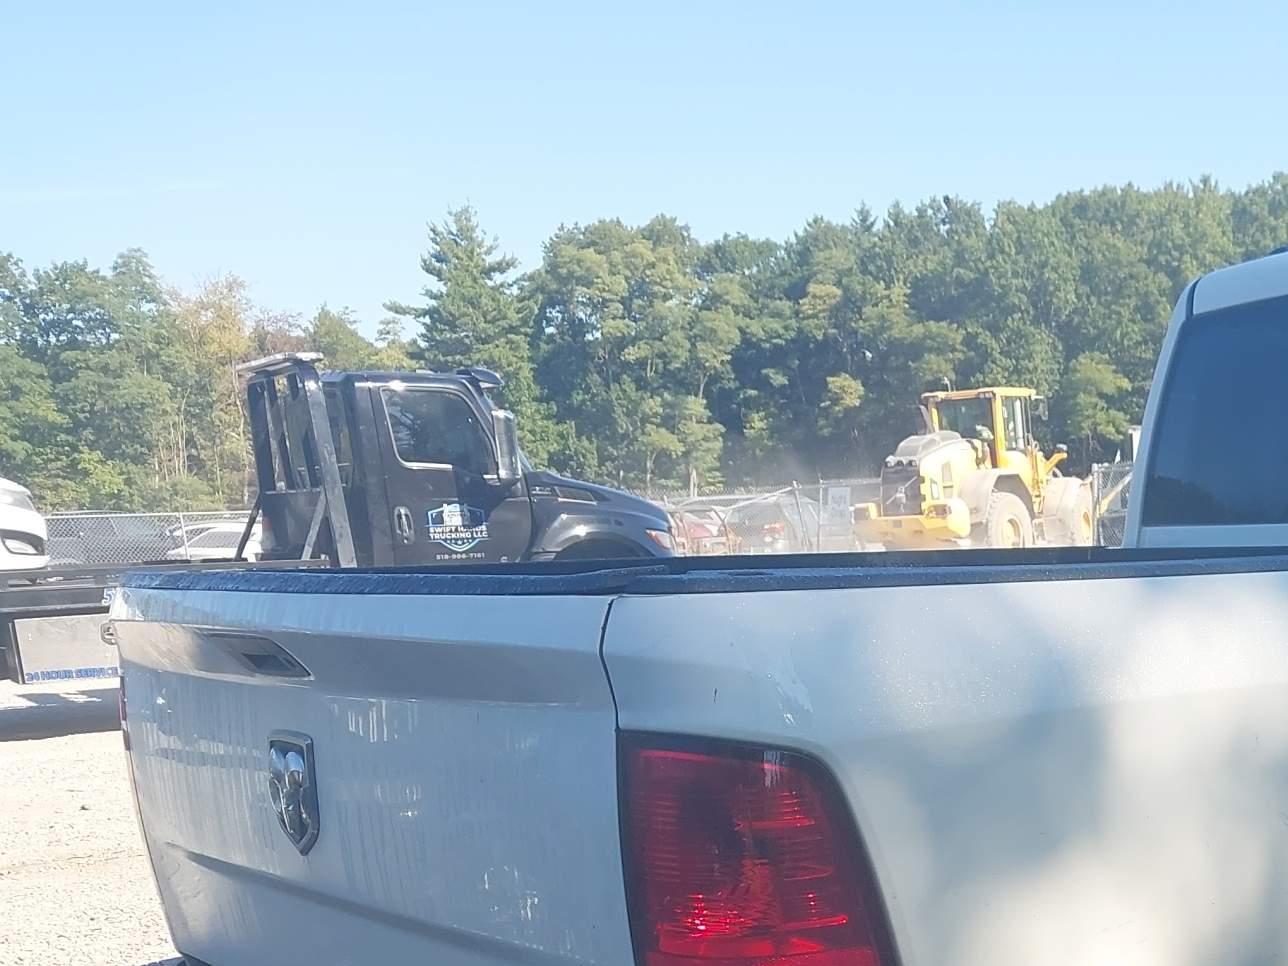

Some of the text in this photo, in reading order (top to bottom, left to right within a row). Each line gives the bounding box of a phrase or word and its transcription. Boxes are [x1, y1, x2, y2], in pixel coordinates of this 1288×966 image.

[429, 532, 472, 540] TRUCKING
[25, 666, 119, 682] 24 HOUR SERVICE
